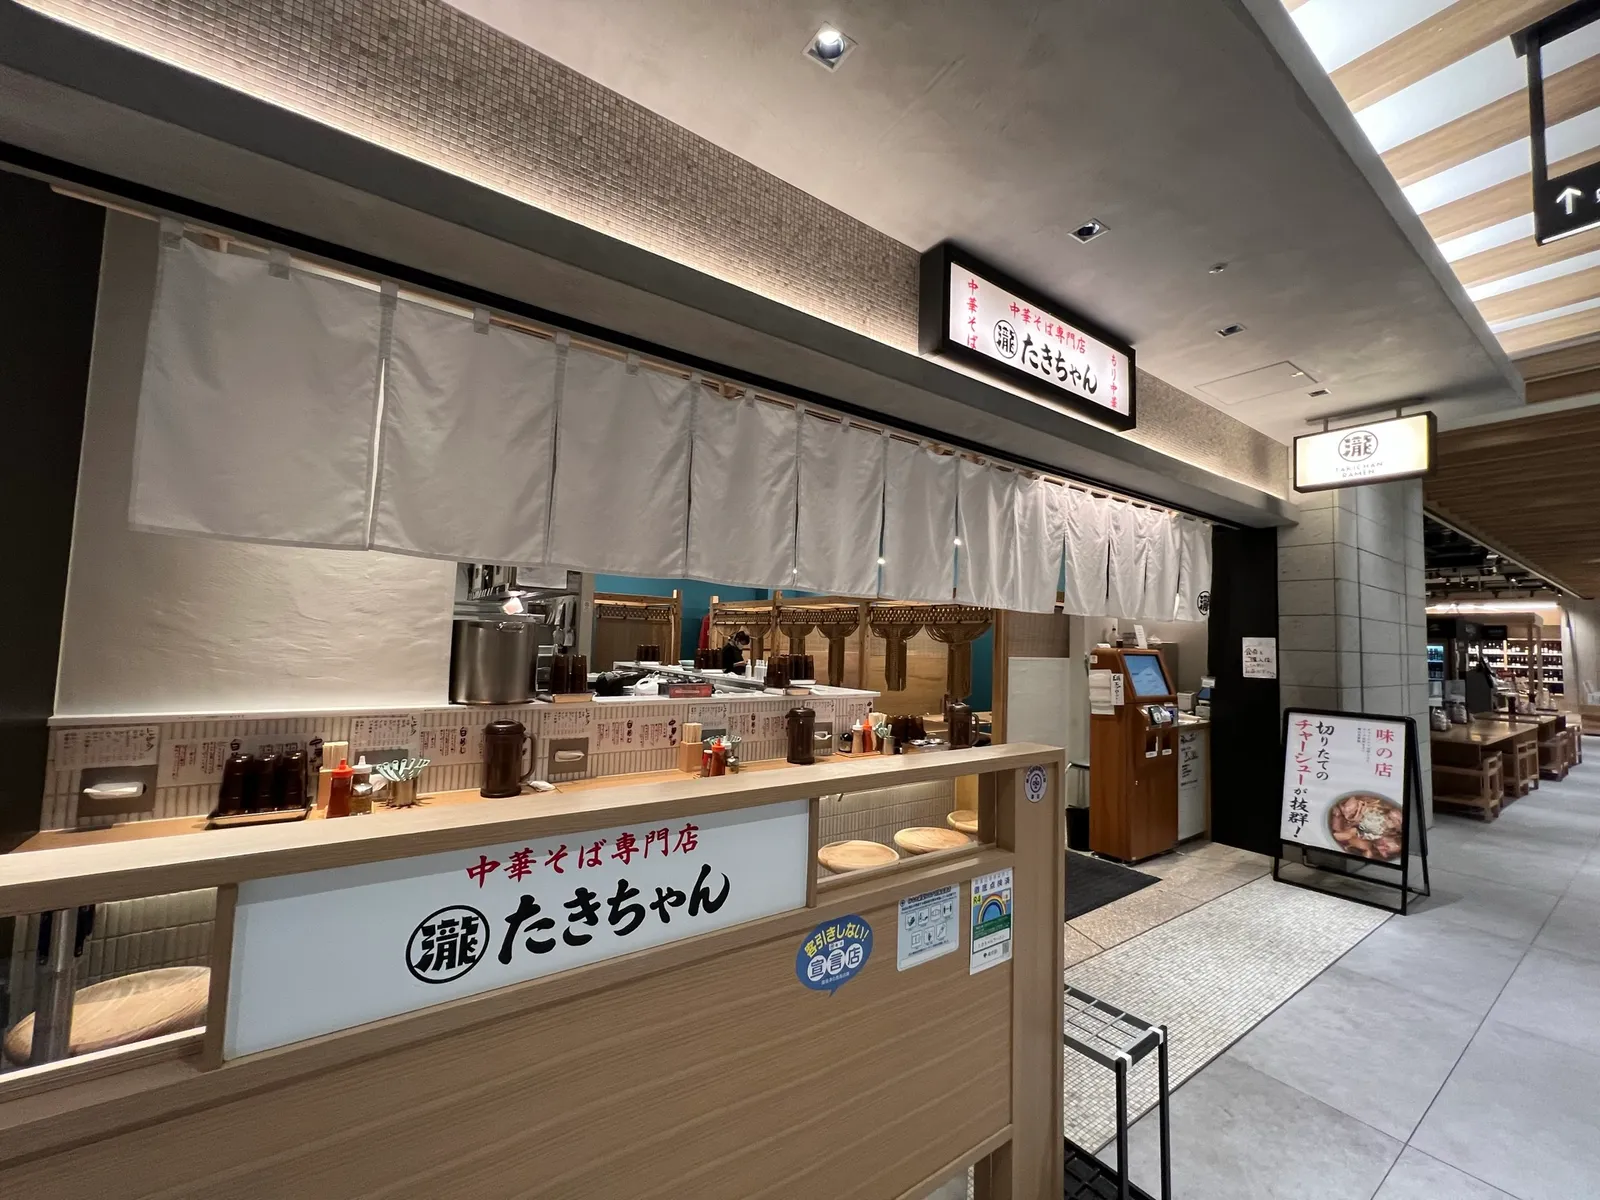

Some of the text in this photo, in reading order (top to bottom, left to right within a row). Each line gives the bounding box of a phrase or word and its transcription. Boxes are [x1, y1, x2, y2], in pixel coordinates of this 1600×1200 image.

[966, 278, 979, 350] 中華そば
[1008, 301, 1087, 355] 中華そば専門店
[1021, 332, 1098, 395] たきちゃん
[1335, 461, 1384, 473] TAKICHAN
[1342, 469, 1375, 478] RAMEN
[1315, 720, 1335, 781] 切りたての
[1375, 728, 1395, 778] 味の店
[466, 822, 700, 889] 中華そば専門店
[498, 863, 731, 965] たきちゃん
[804, 921, 870, 958] 客引きしない!
[810, 946, 862, 979] 宣言店
